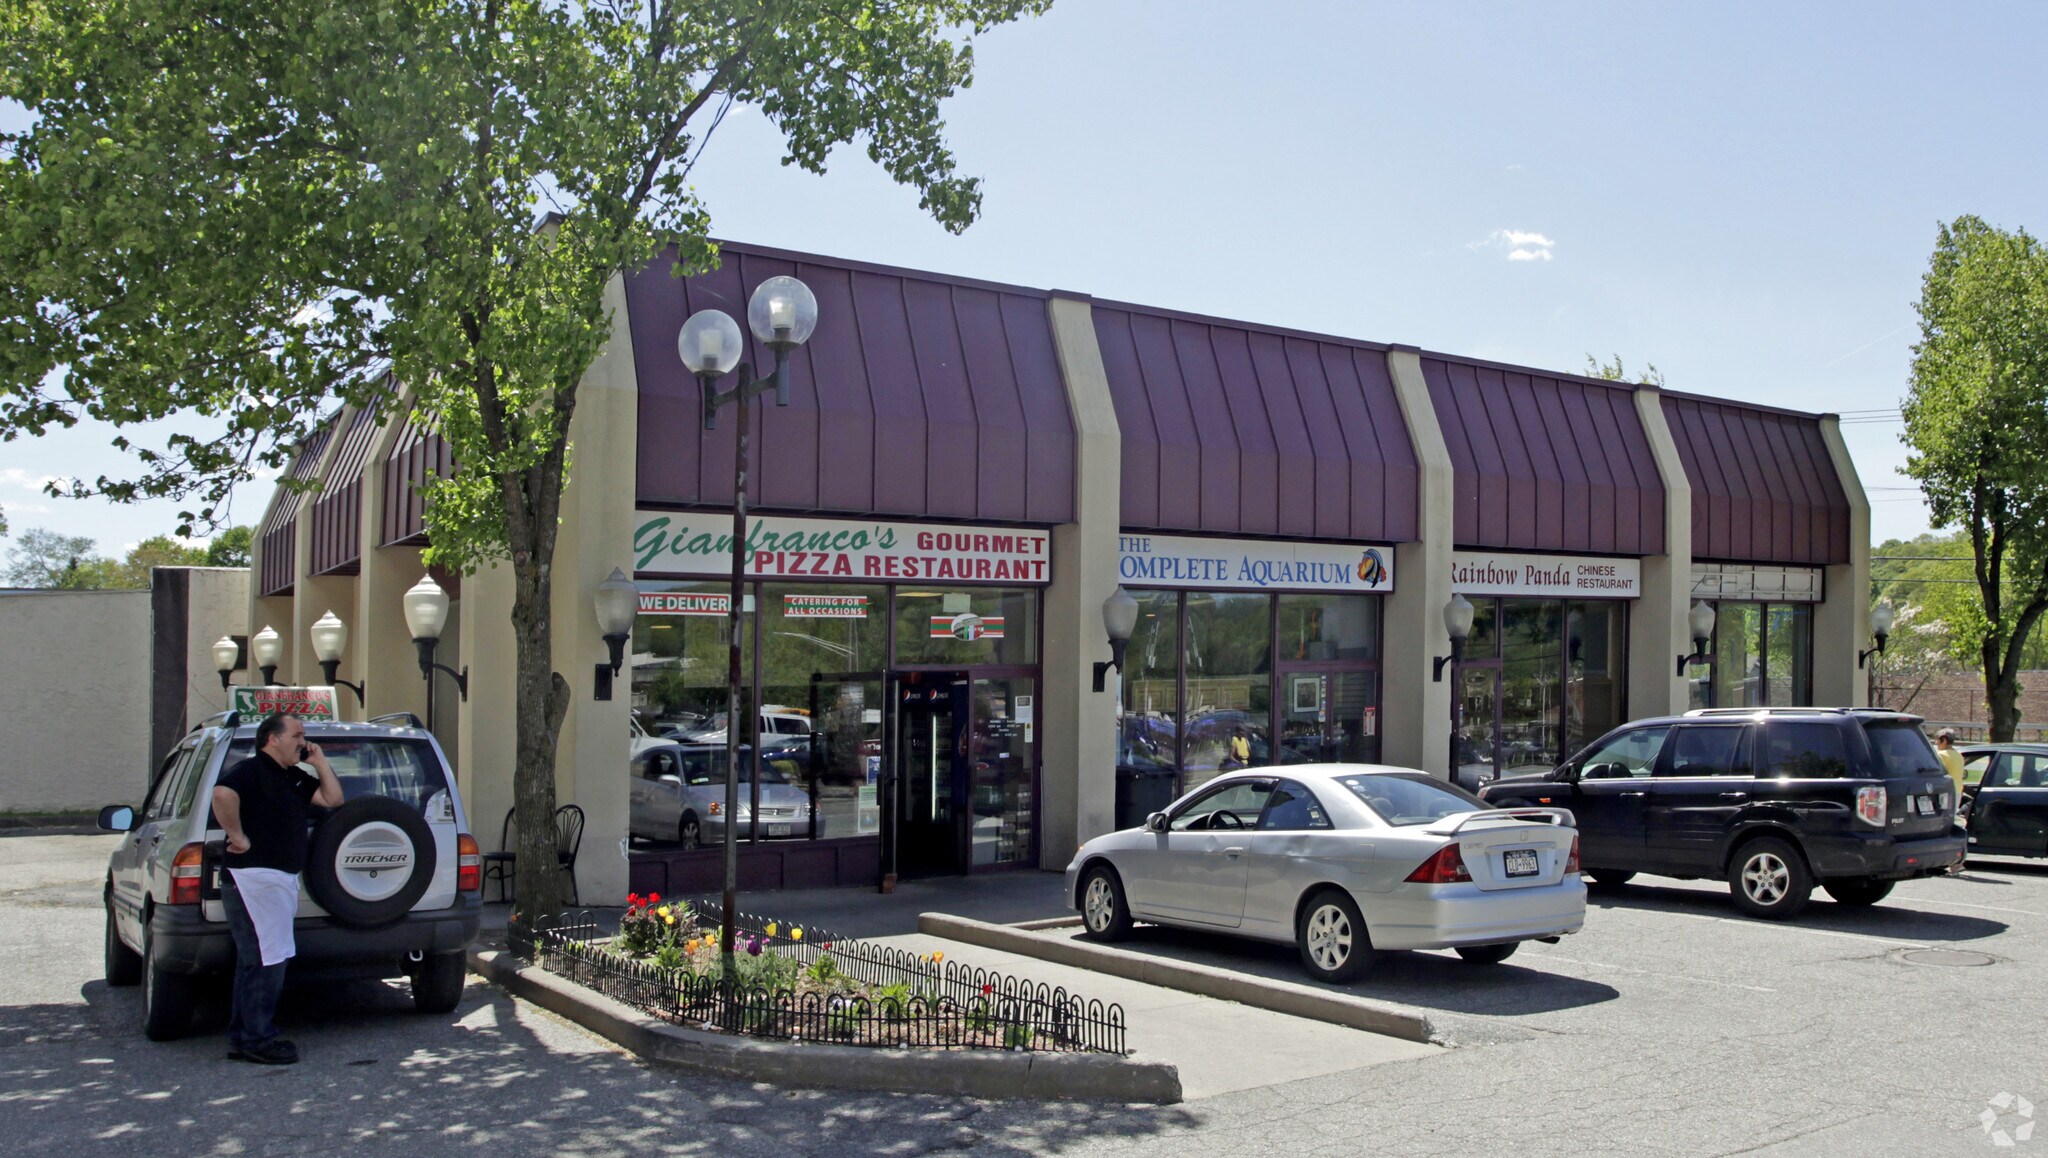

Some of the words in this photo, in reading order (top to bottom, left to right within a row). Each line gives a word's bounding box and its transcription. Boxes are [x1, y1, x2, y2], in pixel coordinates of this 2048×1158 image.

[634, 516, 898, 570] Gianfranco's
[917, 531, 1046, 554] GOURMET
[1119, 536, 1152, 553] THE
[754, 551, 853, 575] PIZZA
[864, 555, 1047, 580] RESTAURANT
[1119, 555, 1228, 581] OMPLETE
[1237, 555, 1351, 586] AQUARIUM
[1577, 565, 1616, 577] CHINESE
[1524, 563, 1571, 587] Panda
[1576, 578, 1634, 590] RESTAURANT
[639, 596, 663, 610] WE
[666, 596, 728, 612] DELIVER
[791, 597, 838, 606] CATERING
[841, 598, 860, 607] FOR
[788, 607, 806, 615] ALL
[808, 607, 863, 615] OCCASIONS
[254, 689, 331, 702] GIANFRANCO'S
[258, 702, 331, 714] PIZZA
[344, 854, 408, 864] TRACKER
